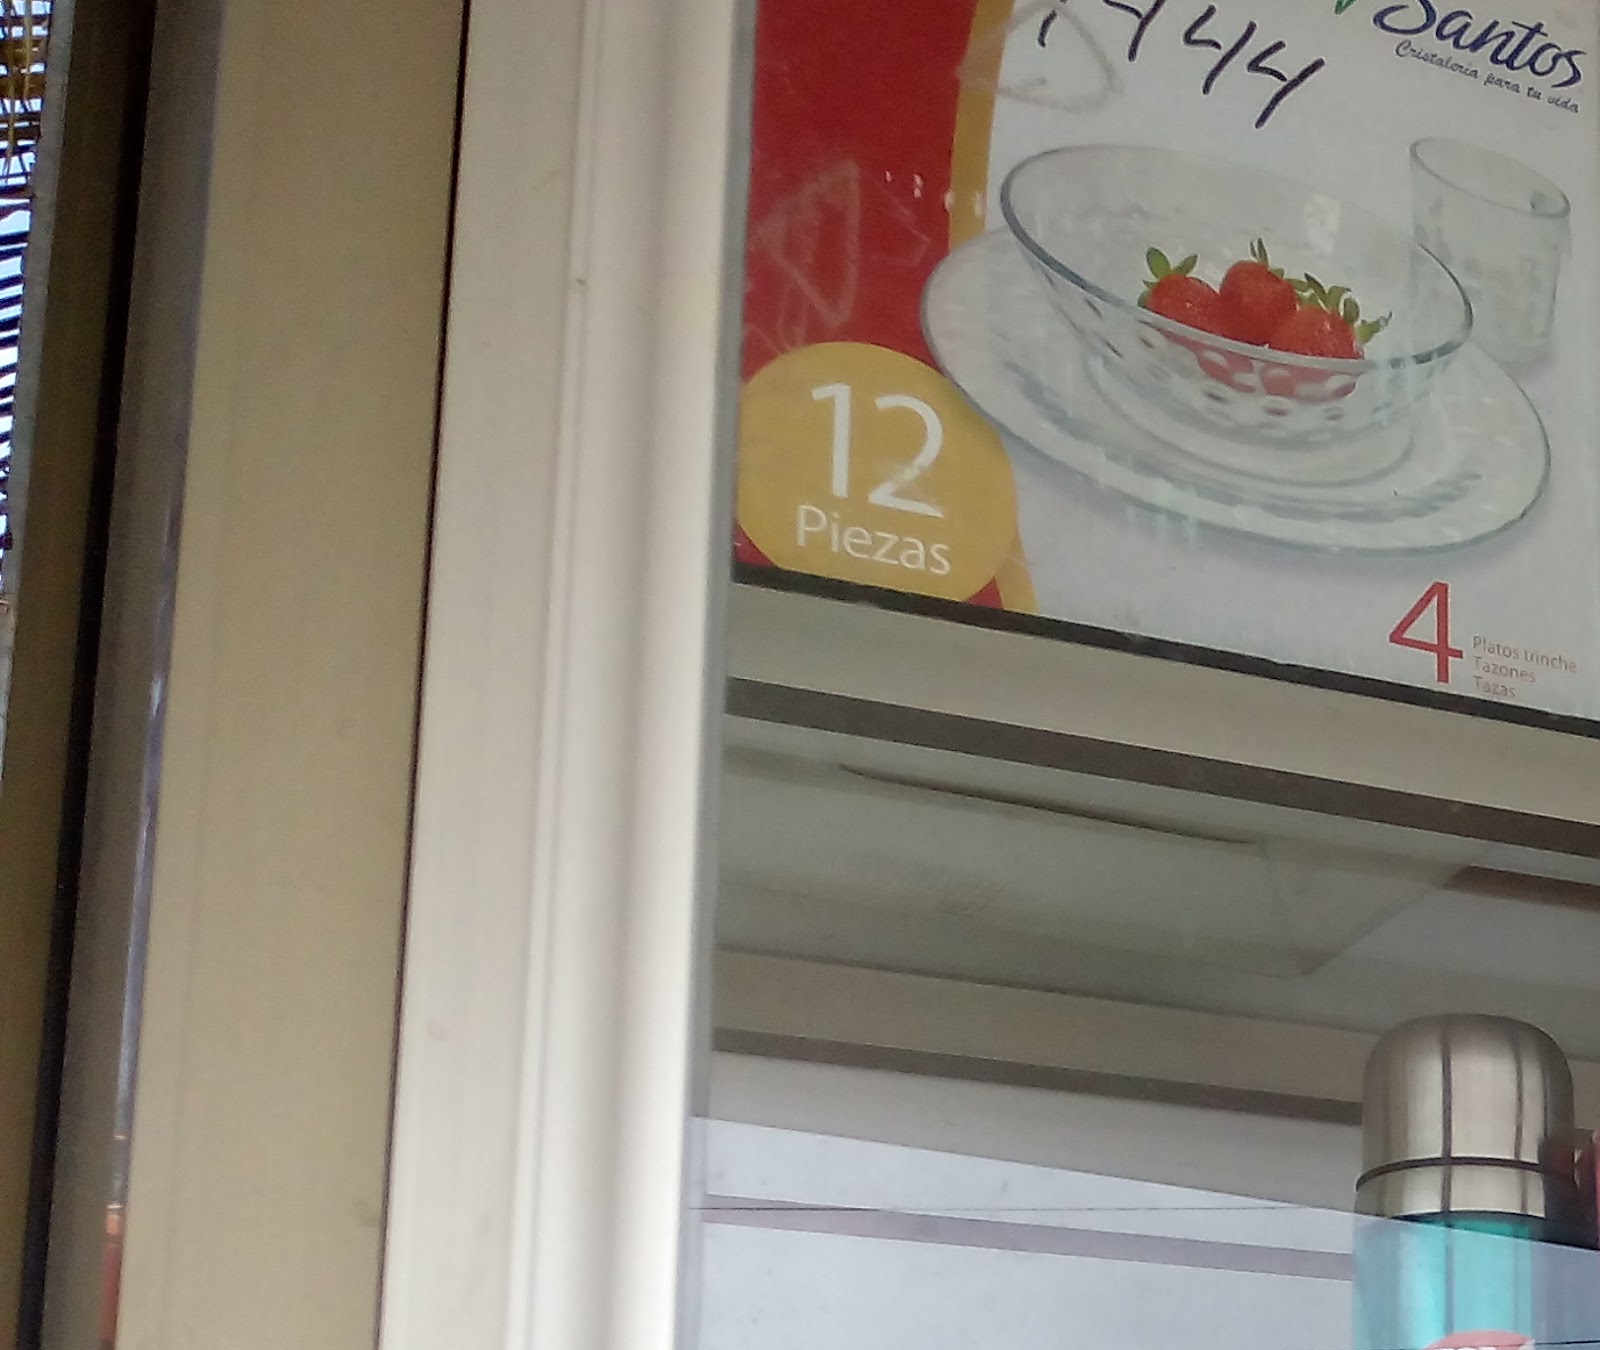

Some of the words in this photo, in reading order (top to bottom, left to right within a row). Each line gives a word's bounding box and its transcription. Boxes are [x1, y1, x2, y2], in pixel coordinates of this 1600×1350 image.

[808, 380, 947, 521] 12
[796, 504, 953, 578] Piezas
[1389, 581, 1464, 684] 4
[1472, 635, 1520, 659] Platos
[1524, 650, 1578, 674] trinche
[1472, 656, 1537, 684] Tazones
[1473, 675, 1517, 697] Tazas
